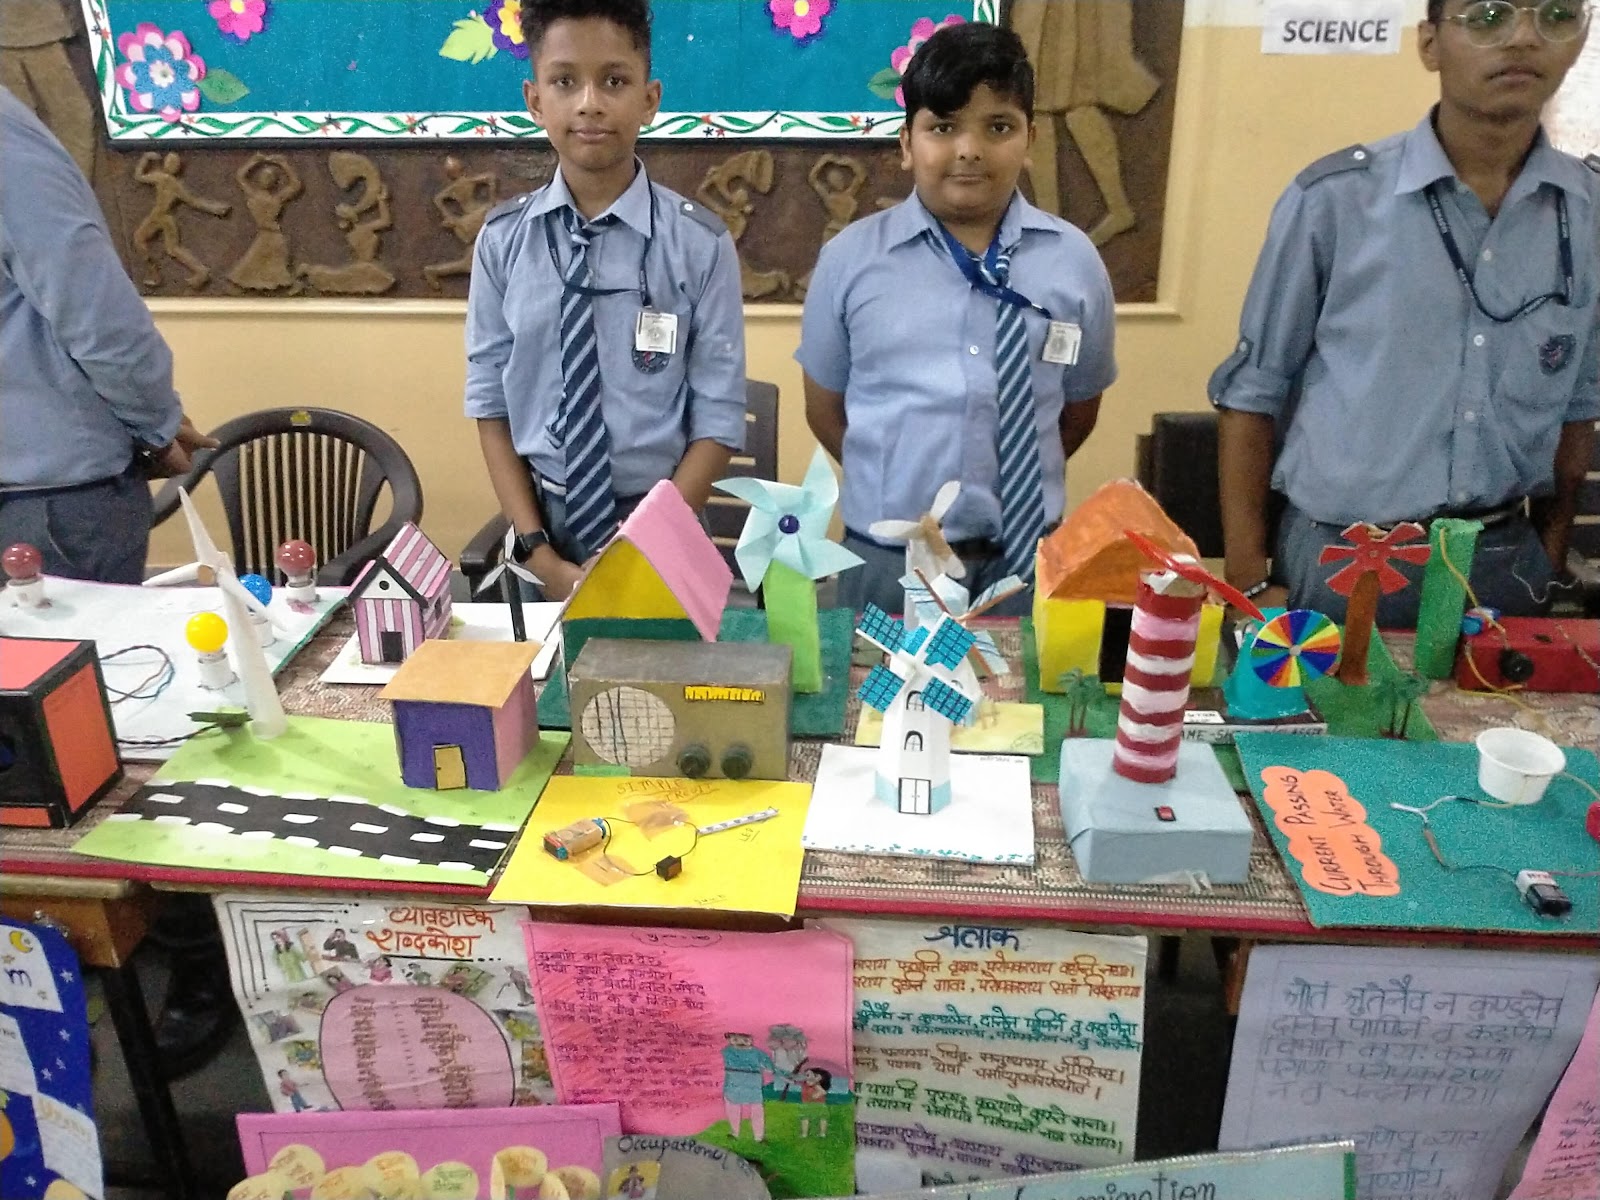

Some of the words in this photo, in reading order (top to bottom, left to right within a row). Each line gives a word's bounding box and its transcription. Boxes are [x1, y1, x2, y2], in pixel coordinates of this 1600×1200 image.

[1283, 19, 1389, 43] SCIENCE
[1320, 790, 1357, 829] WATER
[366, 927, 482, 957] शब्दकोश
